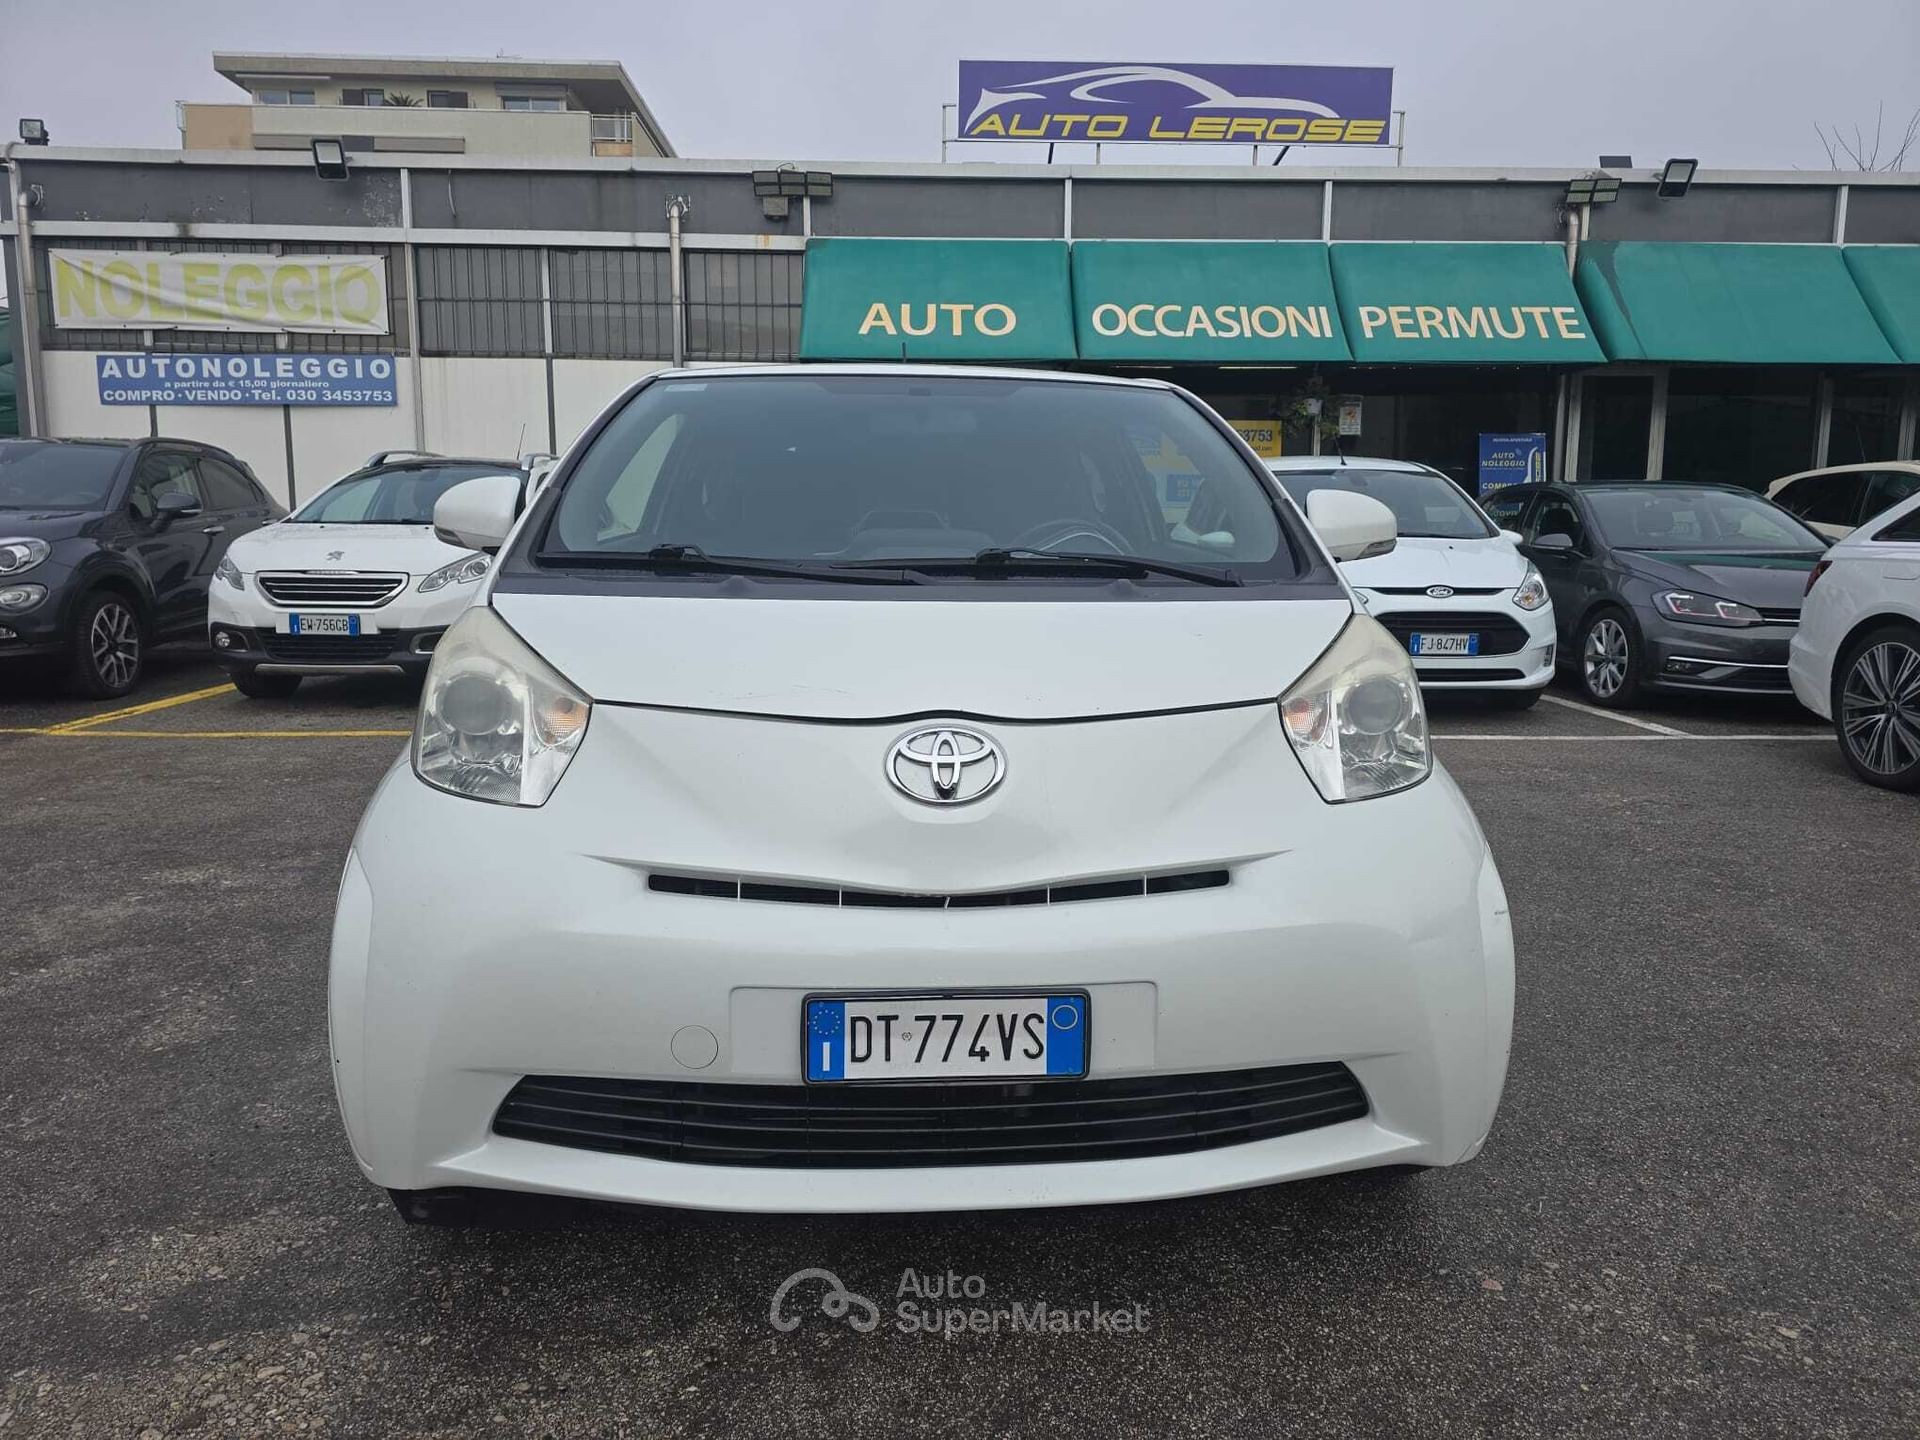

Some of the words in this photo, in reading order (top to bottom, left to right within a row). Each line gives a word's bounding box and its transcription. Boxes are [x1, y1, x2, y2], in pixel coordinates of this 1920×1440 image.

[971, 113, 1128, 137] AUTO
[1149, 116, 1387, 142] LEROSE
[55, 257, 379, 325] NOLEGGIO
[858, 302, 1016, 337] AUTO
[1092, 303, 1333, 340] OCCASIONI
[1362, 305, 1586, 341] PERMUTE
[102, 357, 391, 379] AUTONOLEGGIO
[173, 380, 209, 389] partire
[212, 380, 226, 388] da
[239, 380, 267, 389] 15,00
[270, 380, 330, 389] giornaliero
[103, 389, 175, 401] COMPRO
[184, 389, 242, 401] VENDO
[251, 389, 281, 401] Tel.
[287, 390, 316, 401] 030
[322, 390, 393, 402] 3453753
[850, 1014, 899, 1063] DT
[914, 1013, 1045, 1063] 774VS
